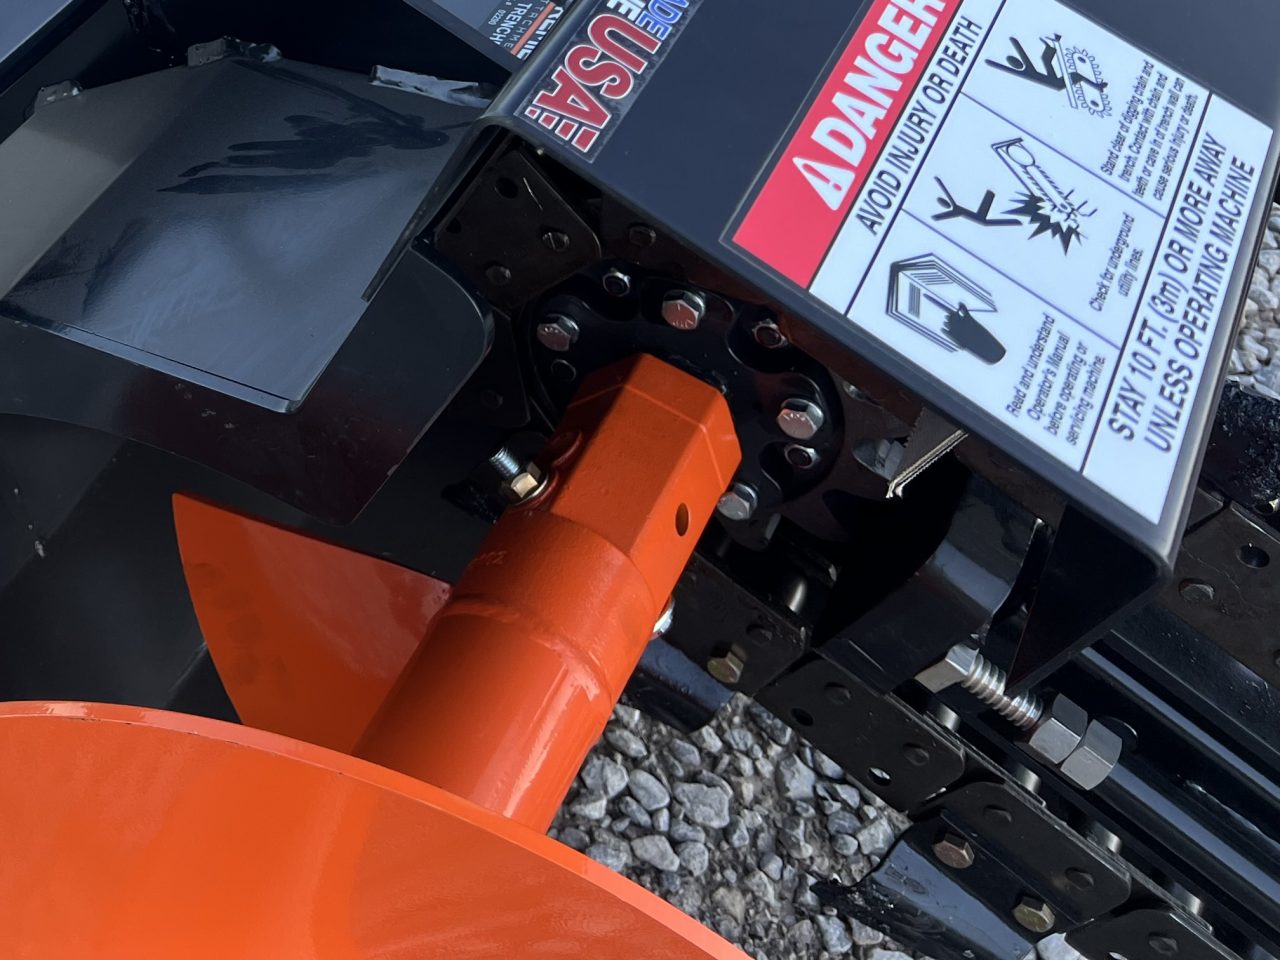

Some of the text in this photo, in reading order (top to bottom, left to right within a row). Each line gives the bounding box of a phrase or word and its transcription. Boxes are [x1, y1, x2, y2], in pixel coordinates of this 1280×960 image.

[532, 13, 662, 130] USA
[855, 15, 983, 236] AVOID INJURY OR DEATH
[1100, 59, 1155, 176] Stand clear of digging chain and
[1117, 71, 1169, 183] trench. Contact with chain and
[1131, 76, 1185, 199] teeth or cave in of trench wall can
[1152, 94, 1199, 201] cause serious injury or death.
[1088, 211, 1135, 312] Check for underground
[1107, 131, 1227, 441] STAY 10 FT. (3m) OR MORE AWAY
[1117, 248, 1144, 298] utility lines.
[1144, 155, 1255, 453] UNLESS OPERATING MACHINE
[1005, 312, 1056, 418] Read and understand
[1026, 330, 1071, 422] Operator's Manual
[1043, 340, 1088, 437] before operating or
[1065, 355, 1106, 446] servicing machine.
